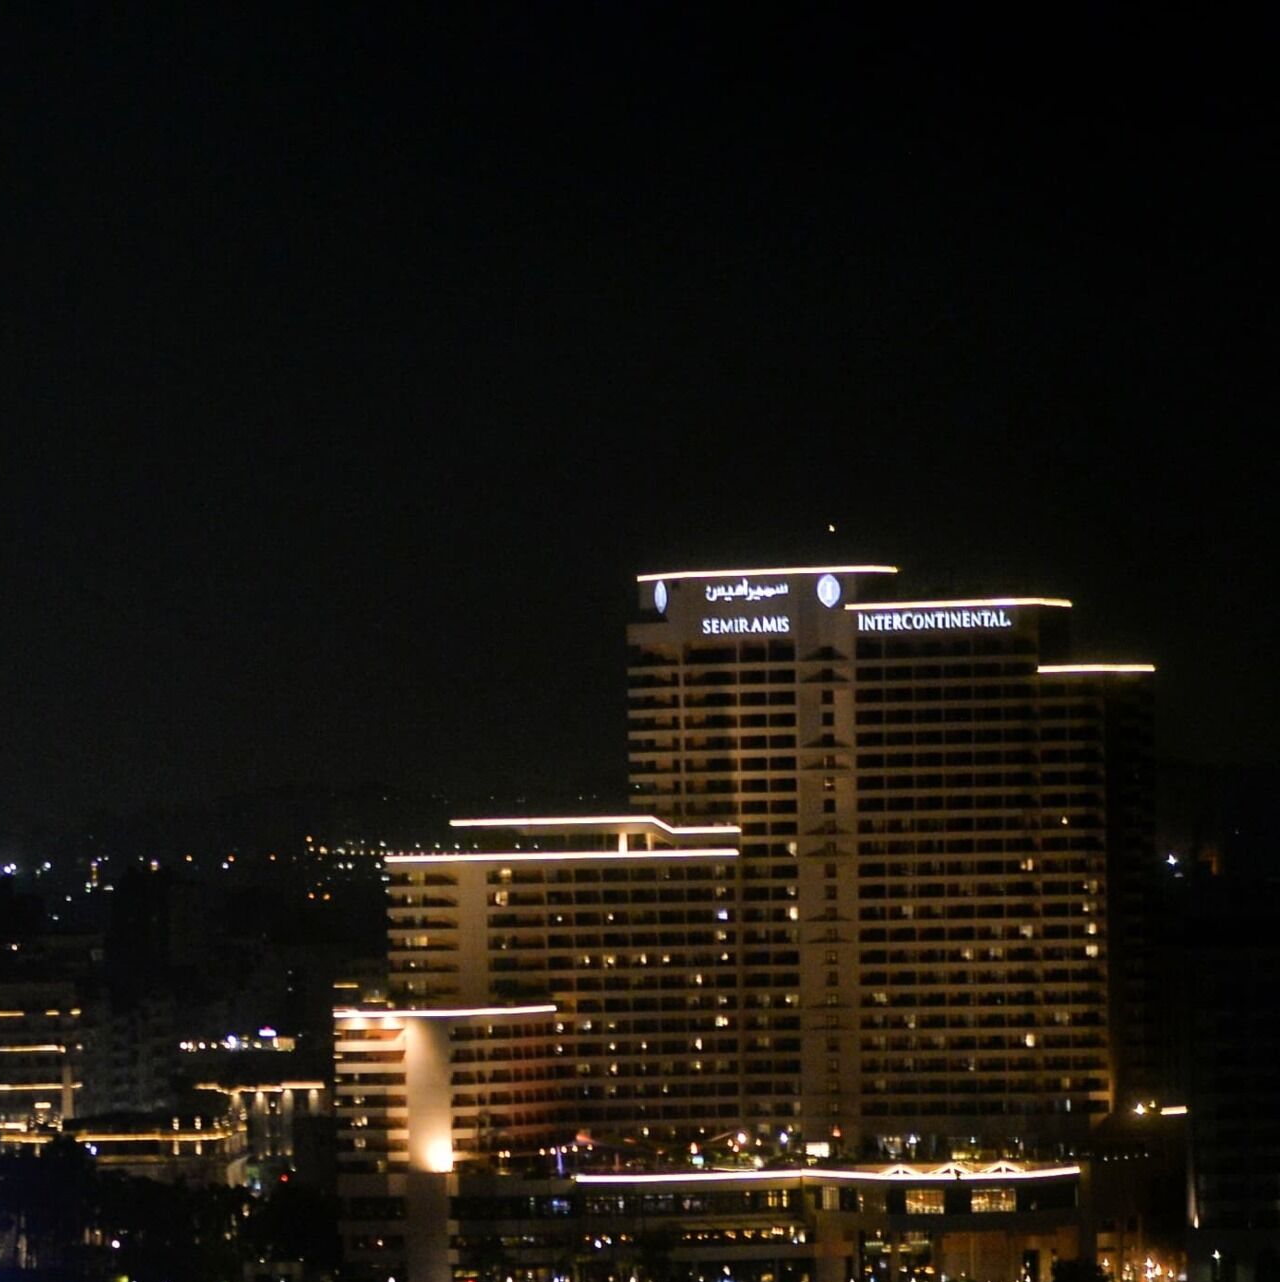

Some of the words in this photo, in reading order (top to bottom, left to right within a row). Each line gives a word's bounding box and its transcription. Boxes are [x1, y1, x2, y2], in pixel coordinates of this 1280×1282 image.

[706, 578, 789, 602] سميراميس
[702, 615, 790, 635] SEMIRAMIS
[857, 609, 1010, 632] INTERCONTINENTAL
